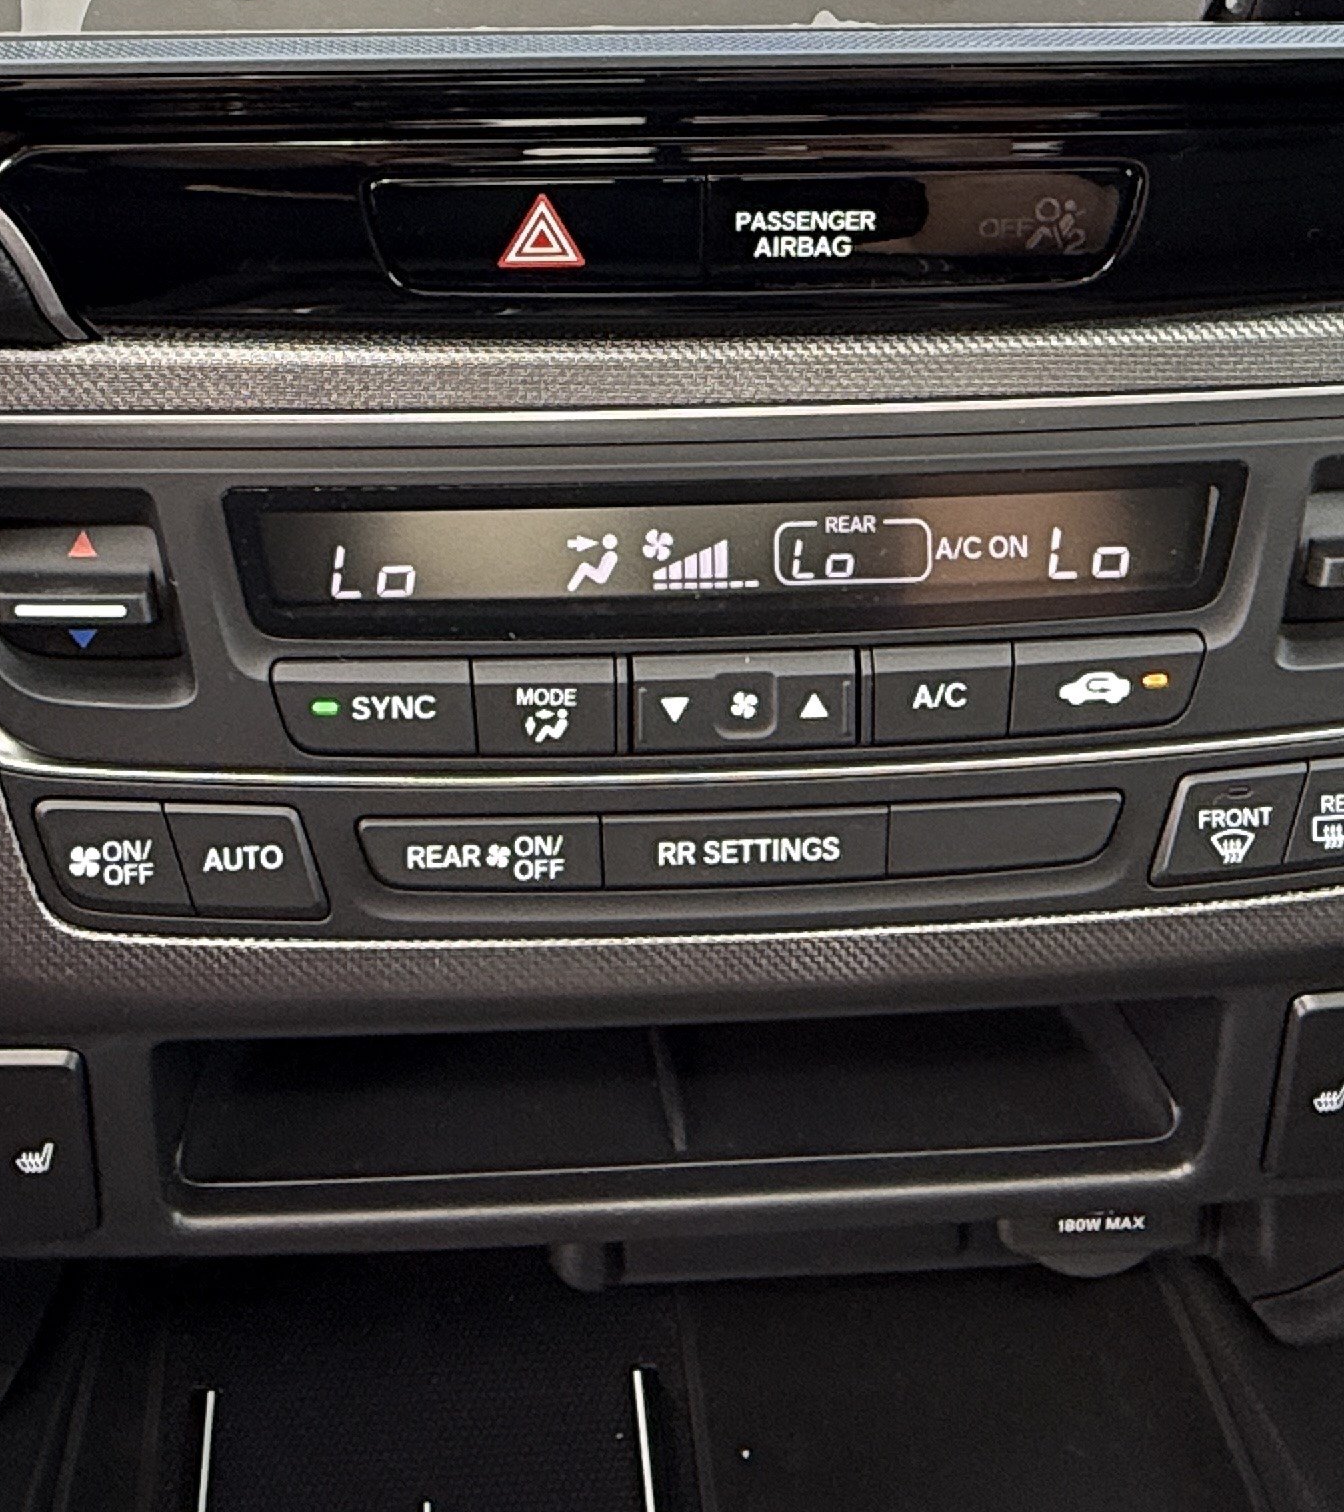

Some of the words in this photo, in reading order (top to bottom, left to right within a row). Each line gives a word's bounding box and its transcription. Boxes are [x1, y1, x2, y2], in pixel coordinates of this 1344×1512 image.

[735, 210, 876, 232] PASSENGER
[753, 235, 852, 258] AIRBAG
[825, 514, 877, 534] REAR
[934, 534, 983, 560] A/C
[988, 534, 1029, 560] ON
[352, 694, 437, 721] SYNC
[516, 687, 578, 709] MODE
[912, 682, 968, 710] A/C
[1198, 806, 1274, 830] FRONT
[102, 839, 154, 863] ON/
[202, 844, 284, 872] AUTO
[406, 844, 482, 870] REAR
[514, 834, 565, 859] ON/
[658, 840, 696, 866] RR
[702, 836, 840, 865] SETTINGS
[102, 862, 154, 886] OFF
[513, 858, 566, 882] OFF
[1058, 1218, 1102, 1233] 180W
[1105, 1216, 1145, 1230] MAX
